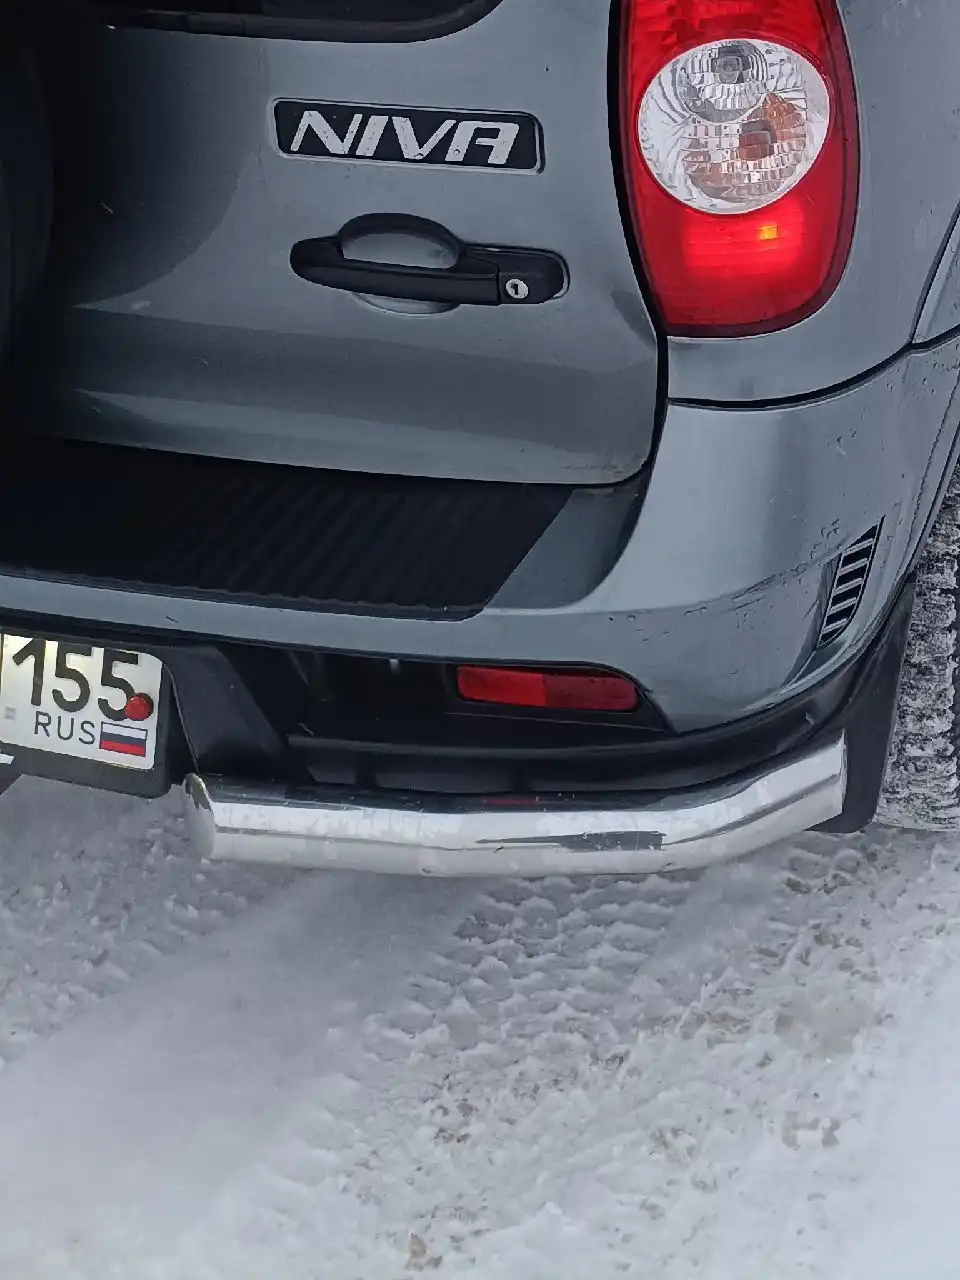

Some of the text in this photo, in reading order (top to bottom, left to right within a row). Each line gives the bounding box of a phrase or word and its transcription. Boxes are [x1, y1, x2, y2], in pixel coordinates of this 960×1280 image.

[290, 110, 520, 165] NIVA
[12, 638, 139, 721] 155
[34, 710, 96, 745] RUS
